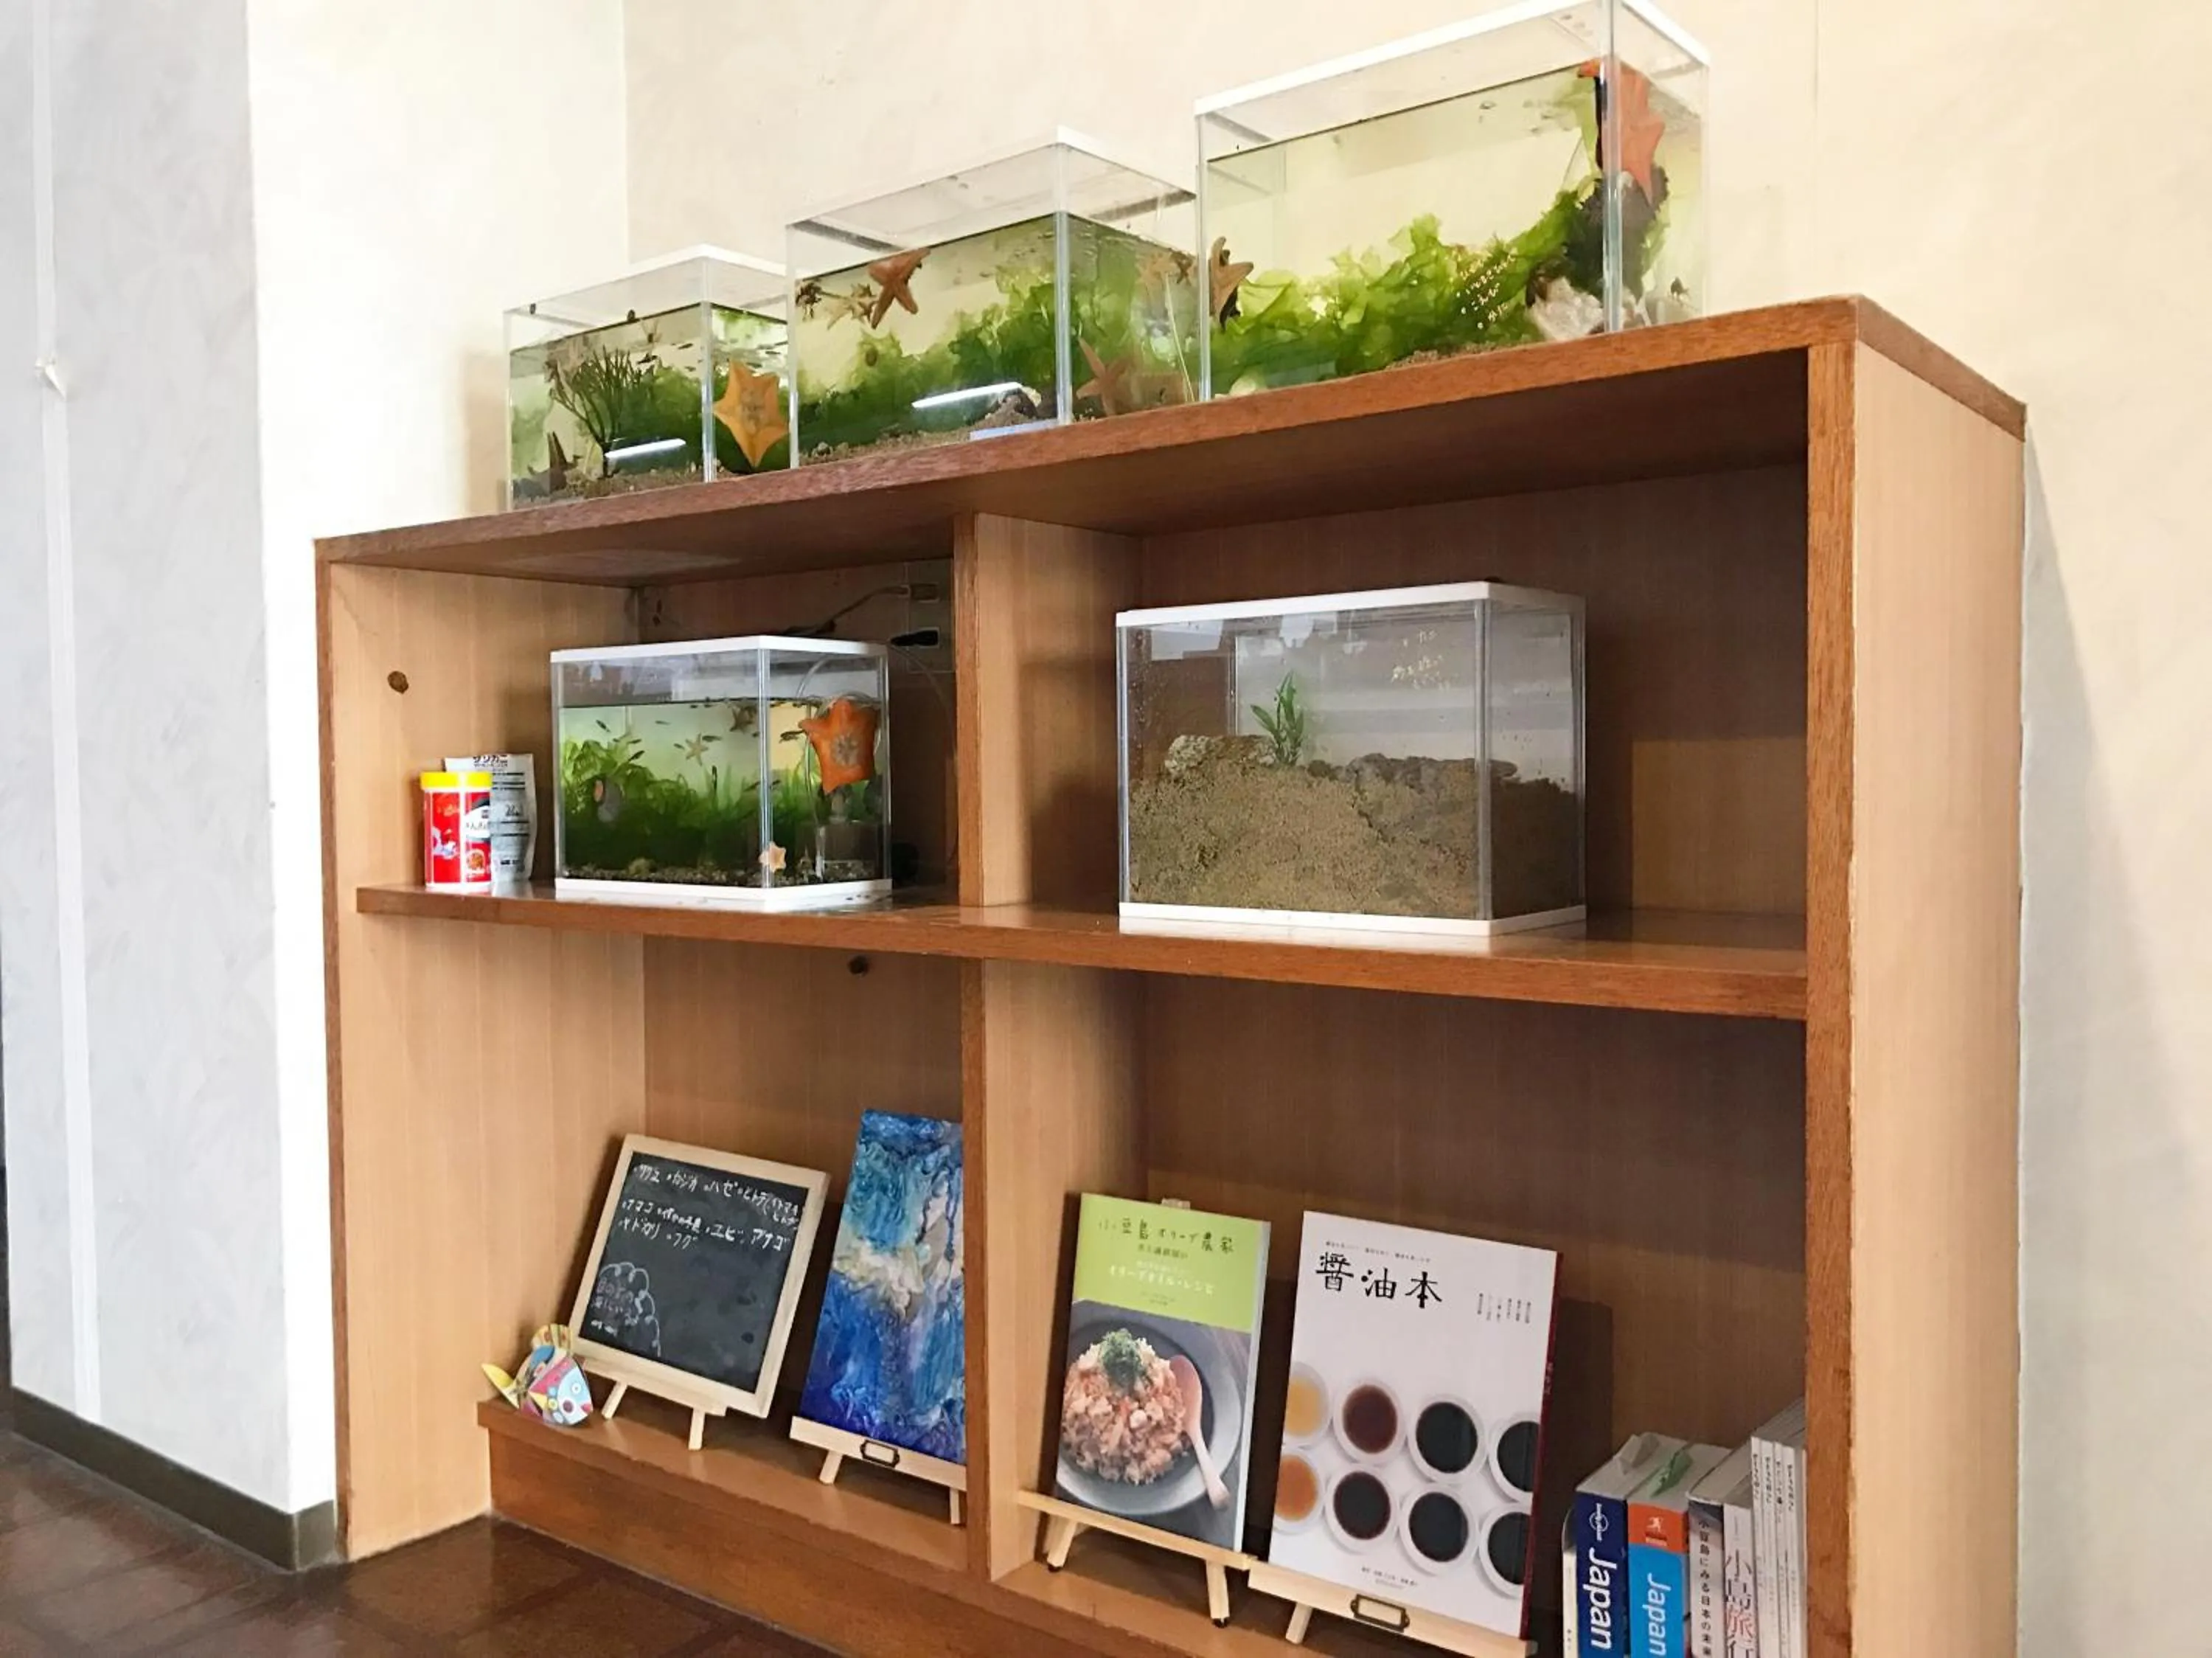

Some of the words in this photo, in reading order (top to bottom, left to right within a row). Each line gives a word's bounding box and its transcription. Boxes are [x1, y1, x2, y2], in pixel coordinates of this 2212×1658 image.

[1316, 1252, 1442, 1308] 醤油本
[1582, 1547, 1617, 1651] Japan
[1642, 1572, 1672, 1656] Japan
